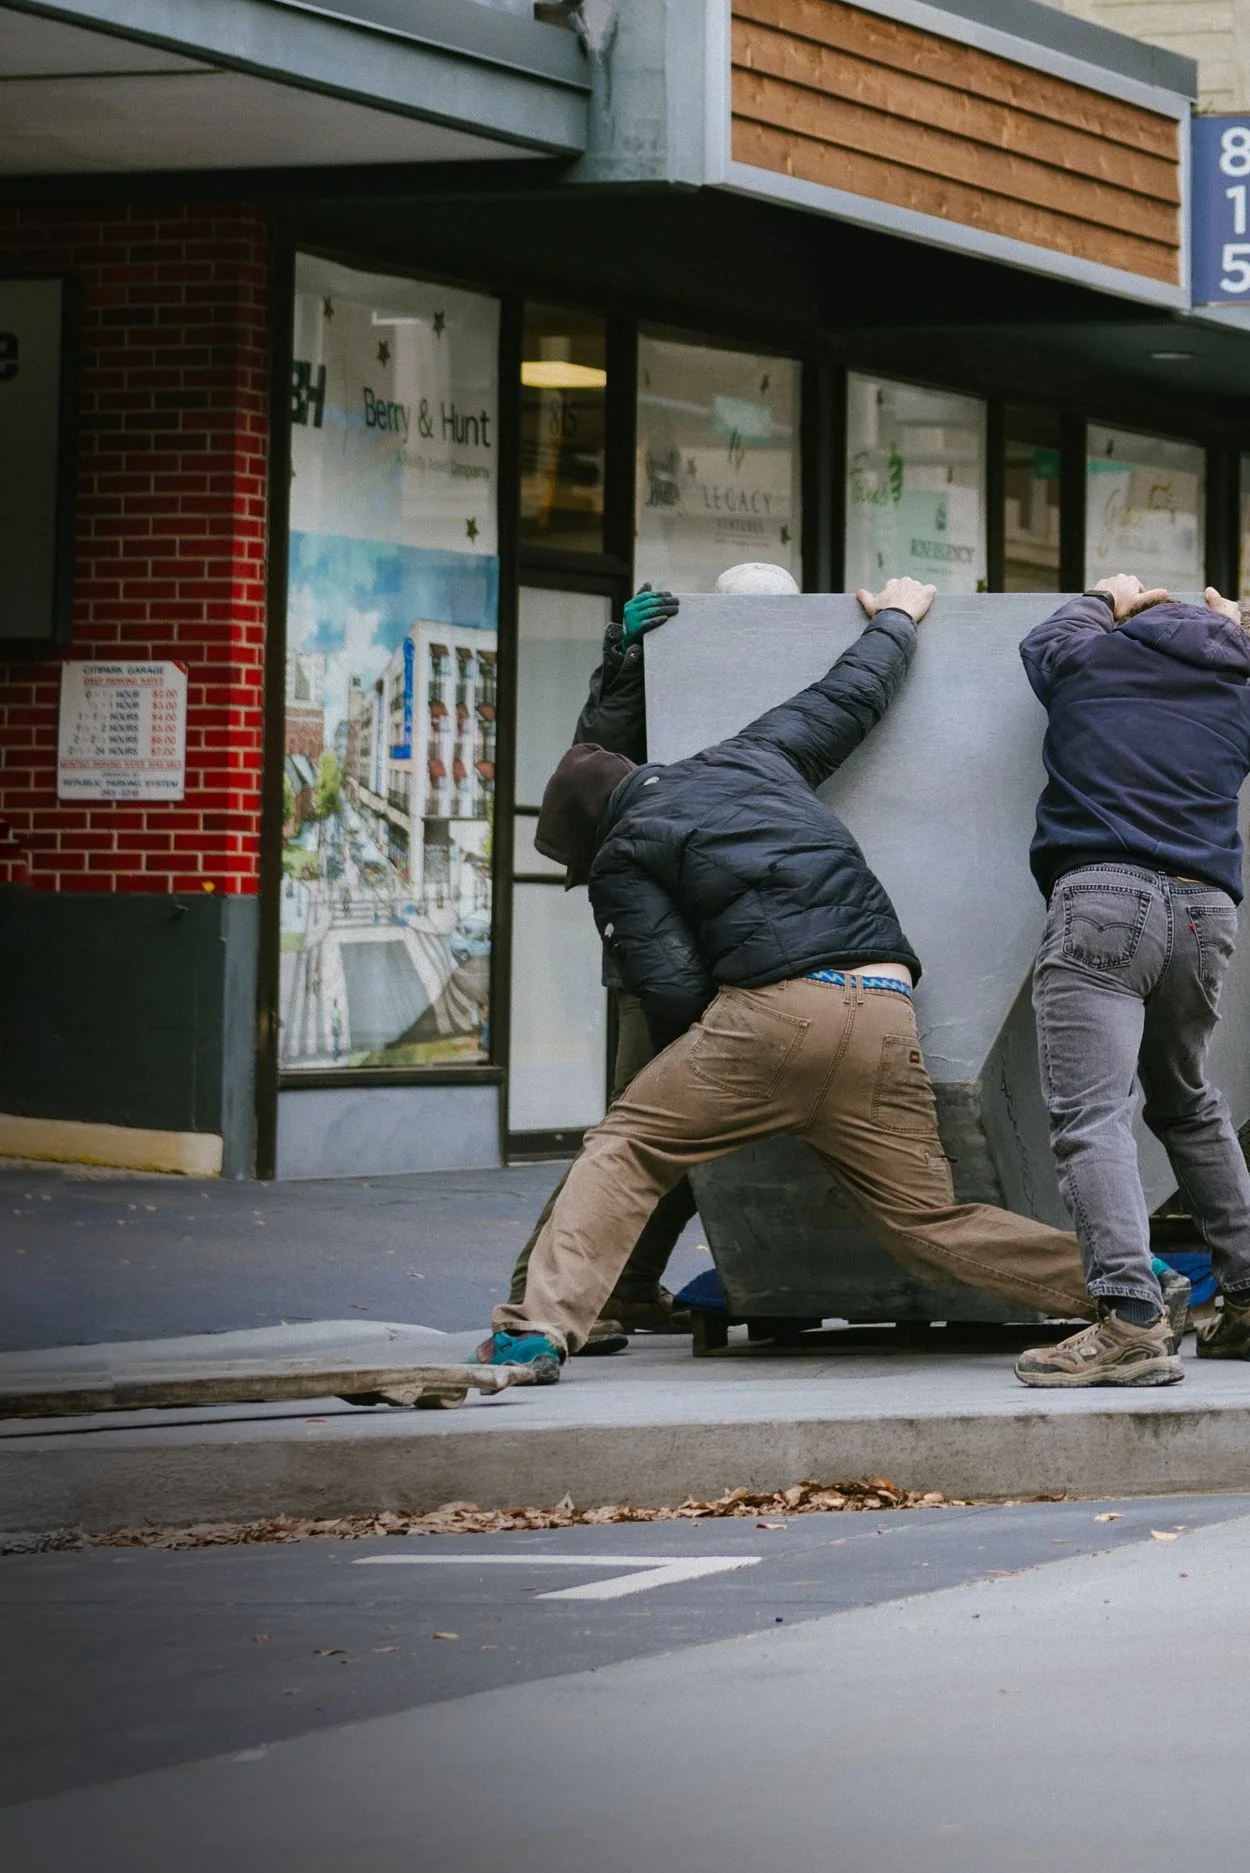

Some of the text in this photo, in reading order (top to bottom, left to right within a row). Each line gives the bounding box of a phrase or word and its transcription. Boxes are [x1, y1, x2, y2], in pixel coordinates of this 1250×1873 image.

[362, 386, 492, 449] Berry & Hunt
[702, 483, 773, 515] LEGACY
